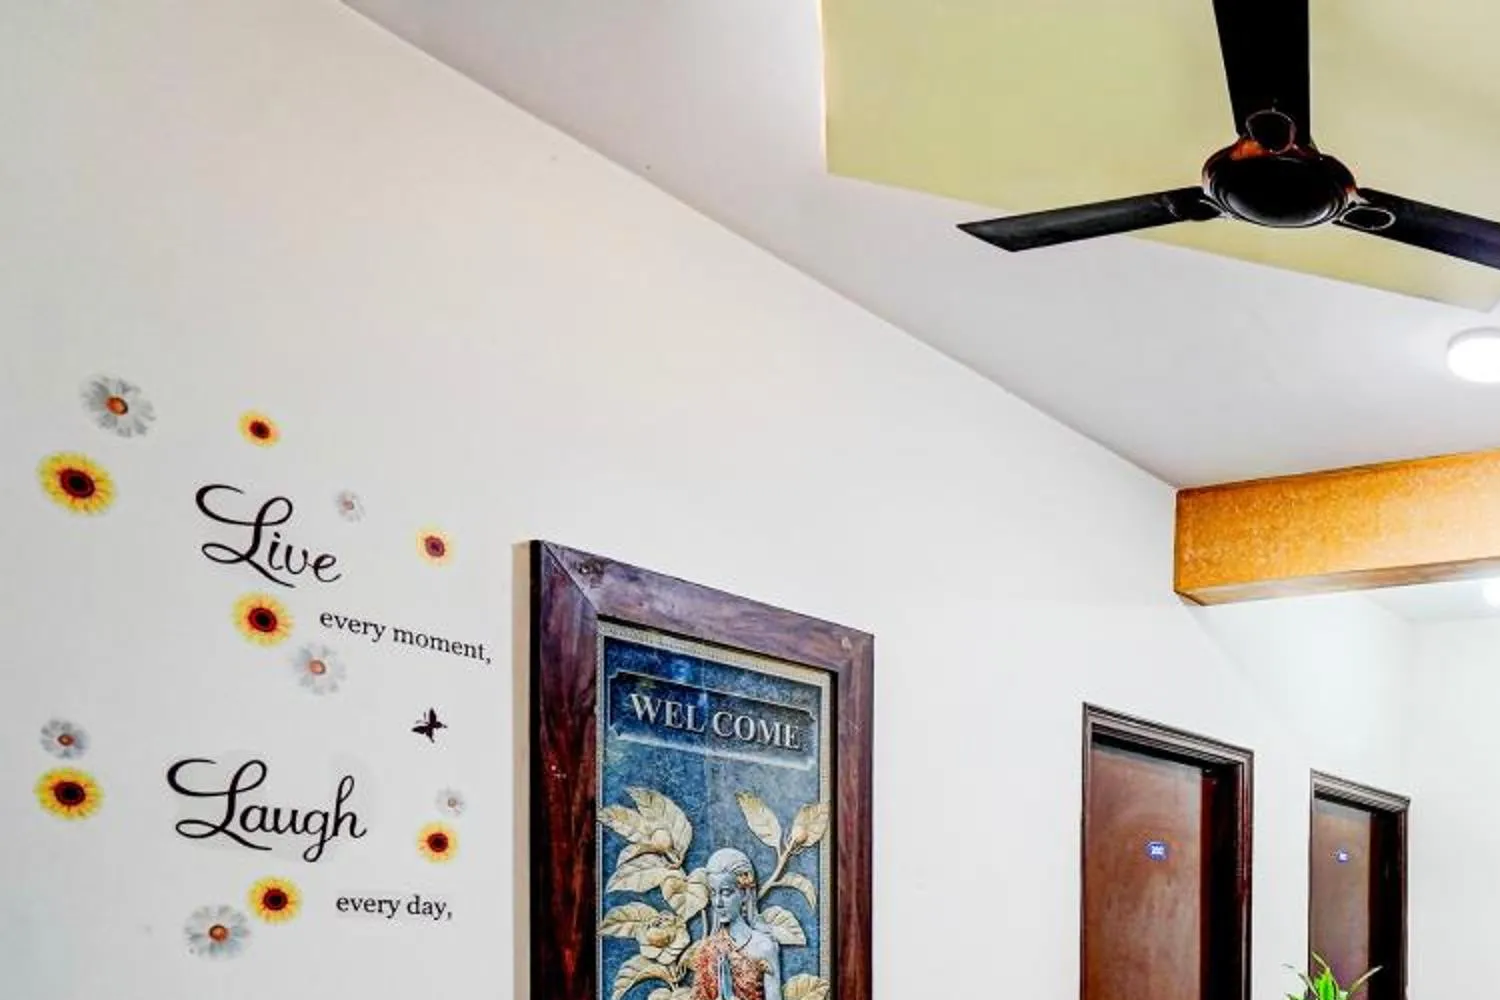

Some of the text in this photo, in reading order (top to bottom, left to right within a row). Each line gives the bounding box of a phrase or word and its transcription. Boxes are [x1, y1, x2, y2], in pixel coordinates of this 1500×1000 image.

[195, 483, 342, 589] Live
[319, 612, 492, 665] every moment,
[166, 758, 368, 863] Laugh
[335, 893, 453, 921] every day,
